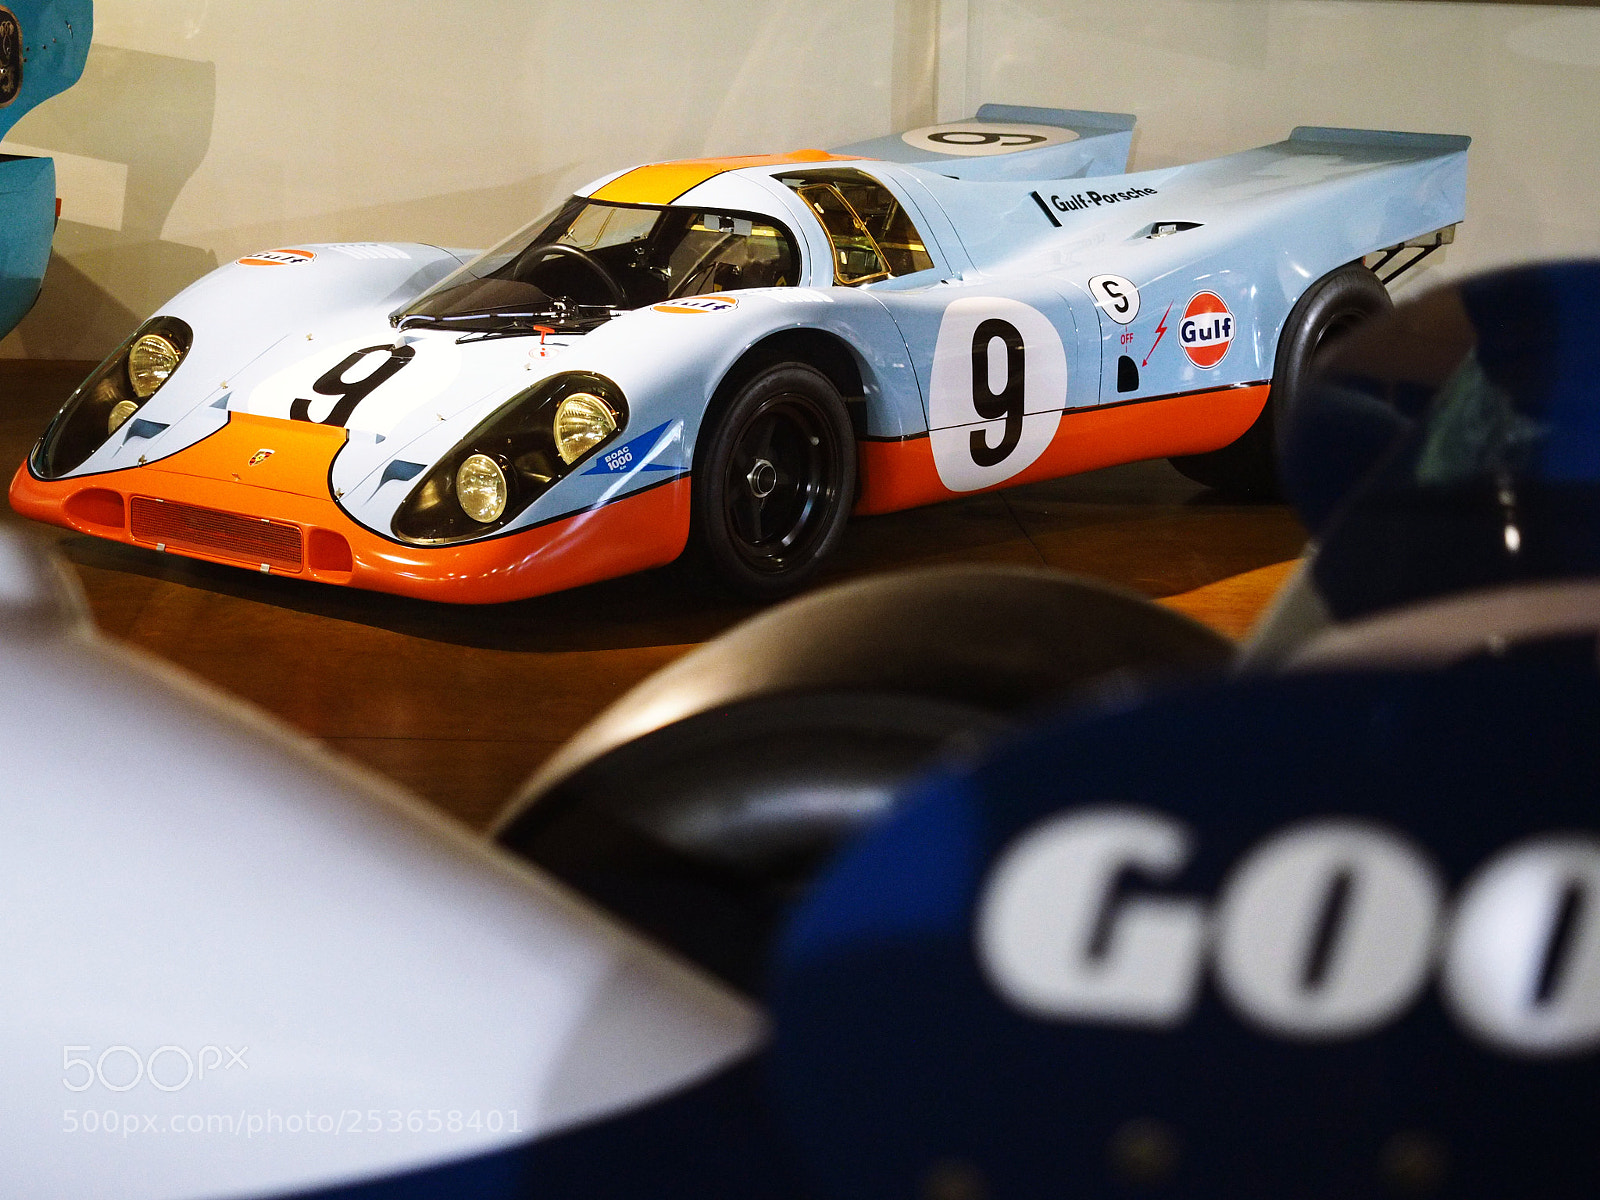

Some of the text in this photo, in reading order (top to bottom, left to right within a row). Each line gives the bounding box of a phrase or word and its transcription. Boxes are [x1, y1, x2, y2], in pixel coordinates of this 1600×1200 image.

[1050, 187, 1158, 212] Gulf-Porsche
[1102, 280, 1129, 313] S
[1120, 333, 1134, 345] OFF
[1181, 317, 1232, 343] Gulf
[290, 344, 416, 427] 9
[970, 318, 1025, 467] 9
[604, 446, 629, 463] BOAC
[607, 452, 632, 471] 1000
